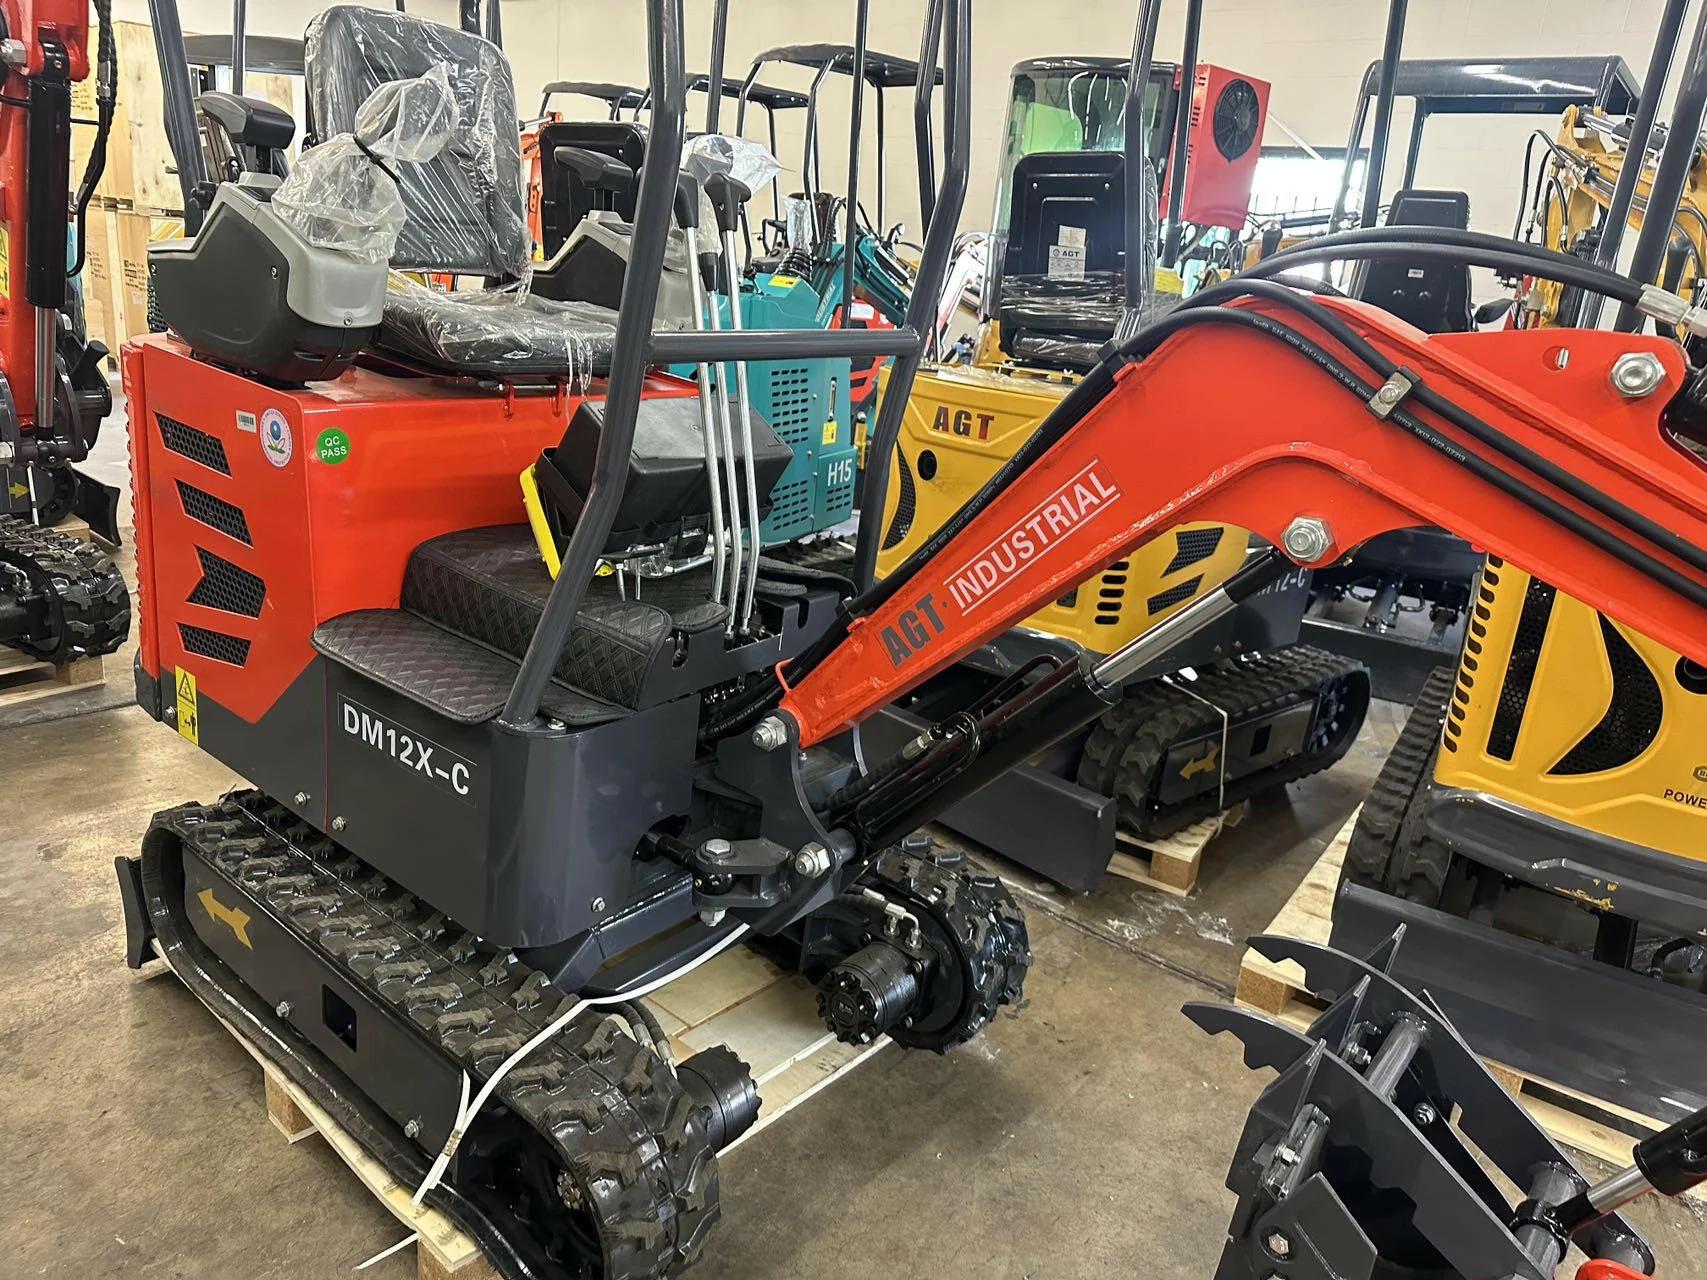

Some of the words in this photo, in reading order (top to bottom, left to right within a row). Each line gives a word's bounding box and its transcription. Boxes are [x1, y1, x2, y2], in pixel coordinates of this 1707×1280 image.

[1062, 250, 1080, 258] AGT
[933, 405, 995, 440] AGT
[321, 445, 347, 459] PASS
[324, 436, 340, 447] QC
[827, 458, 853, 487] H15
[880, 593, 945, 667] AGT
[949, 472, 1117, 609] INDUSTRIAL
[344, 703, 470, 795] DM12X-C
